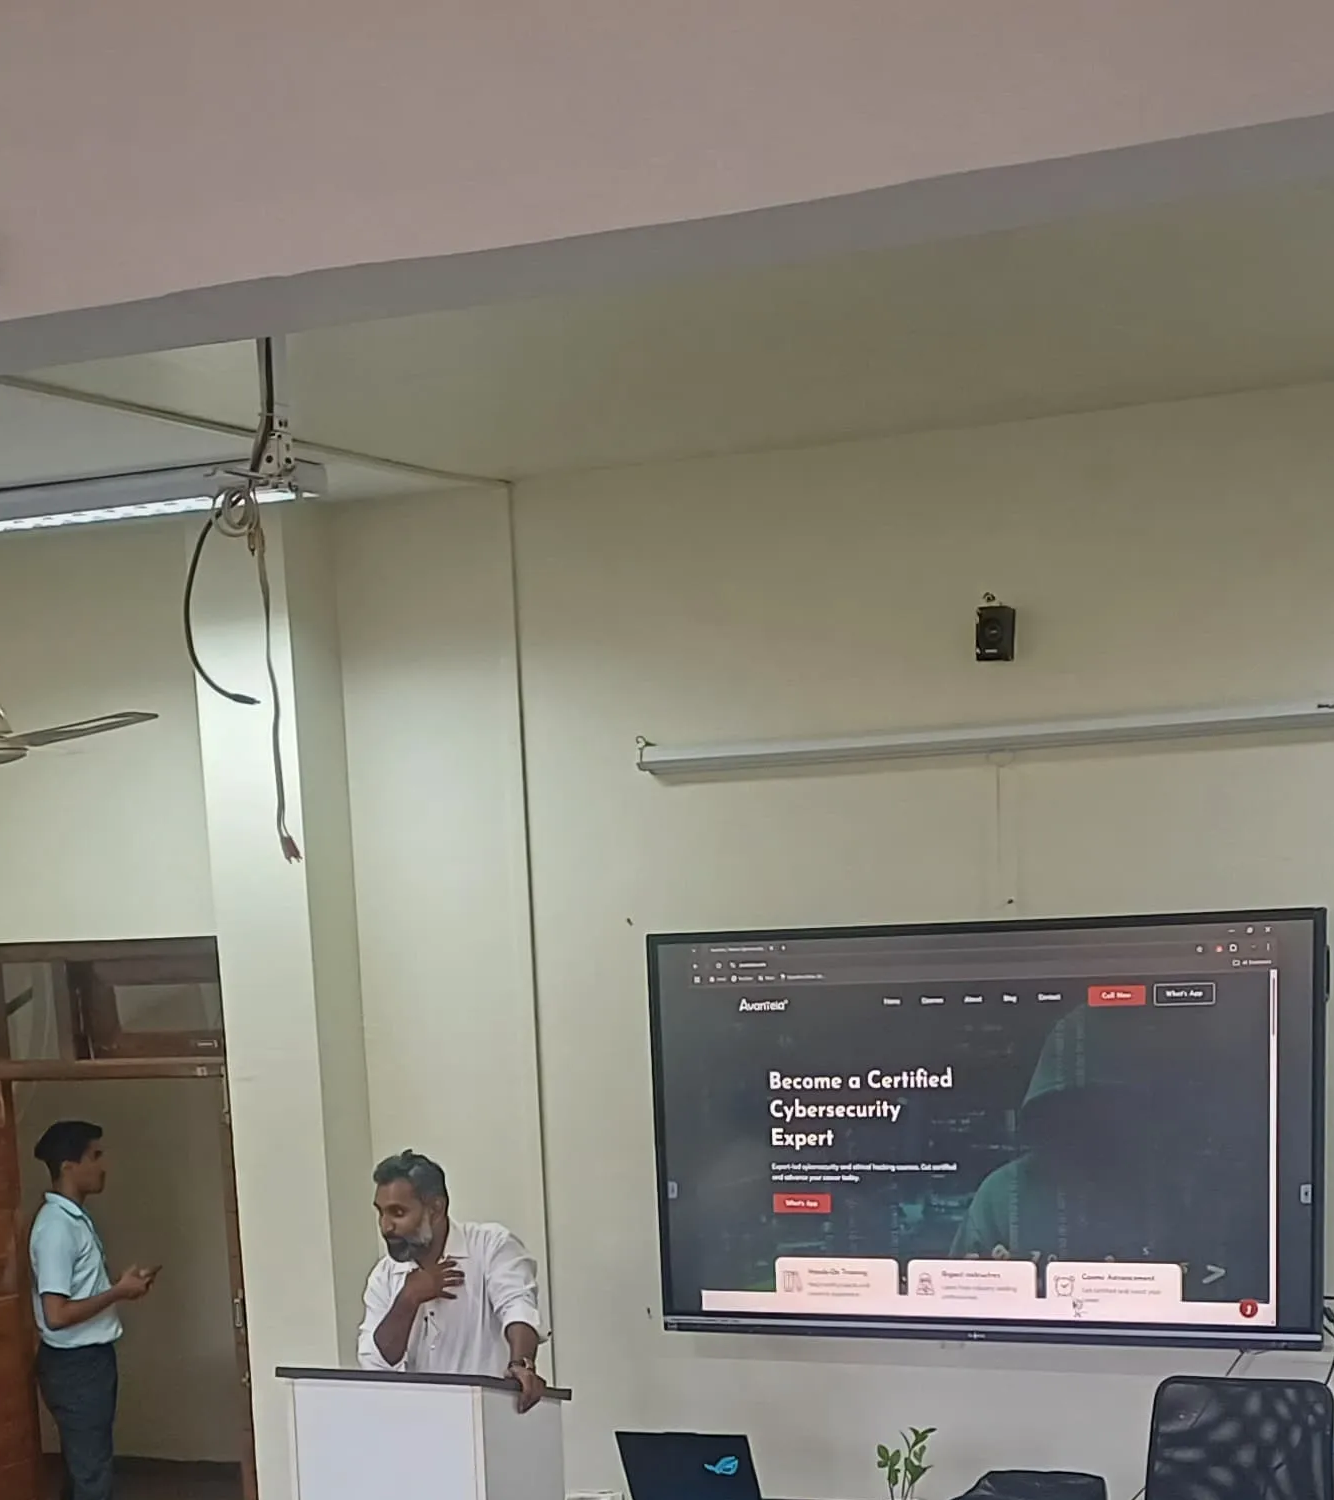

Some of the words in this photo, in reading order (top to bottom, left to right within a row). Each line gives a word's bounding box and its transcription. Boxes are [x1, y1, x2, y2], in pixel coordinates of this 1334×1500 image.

[769, 1071, 842, 1090] Become
[848, 1076, 861, 1089] a
[867, 1067, 953, 1089] Certified
[770, 1098, 901, 1122] Cybersecurity
[771, 1127, 834, 1150] Expert
